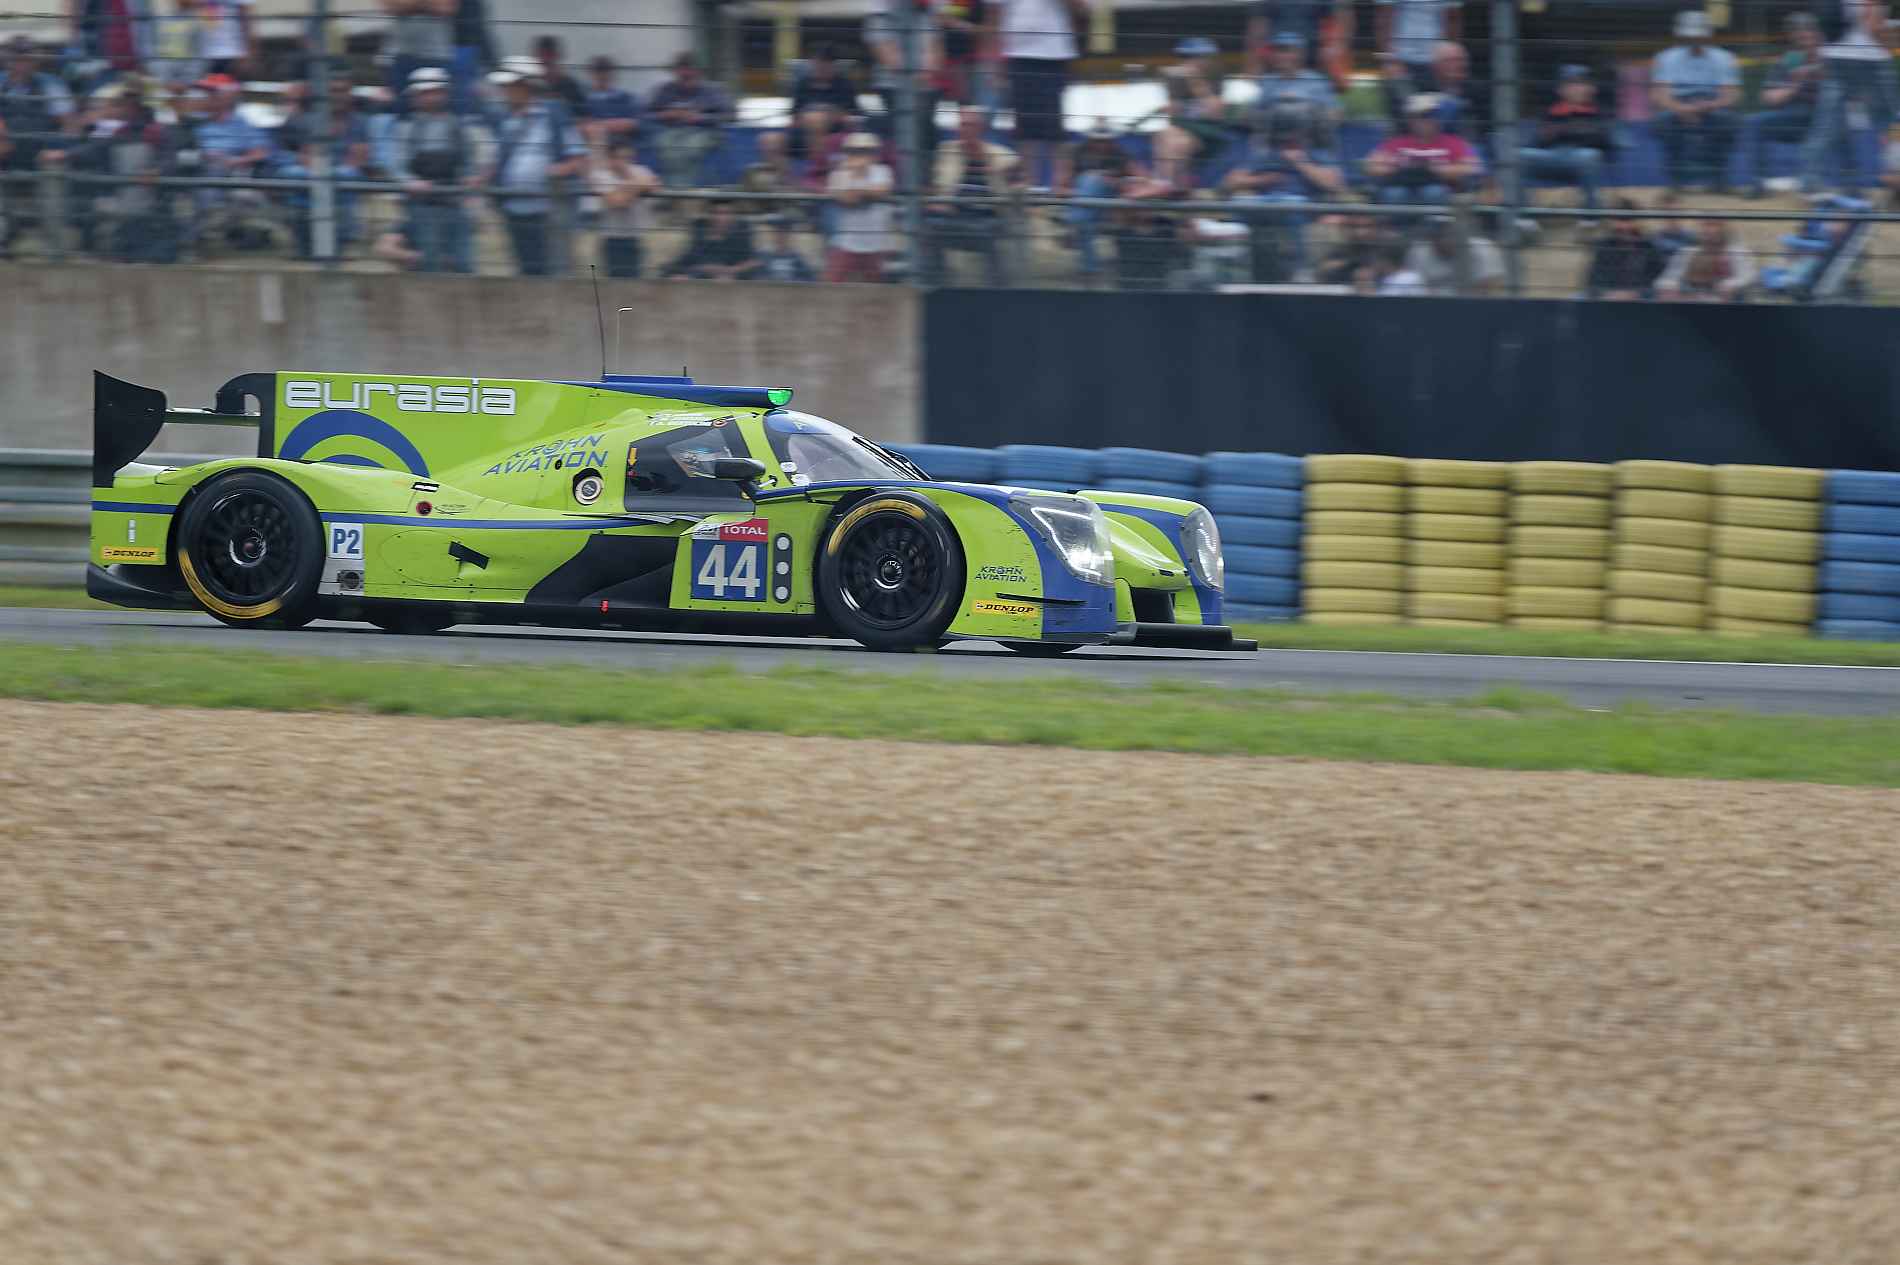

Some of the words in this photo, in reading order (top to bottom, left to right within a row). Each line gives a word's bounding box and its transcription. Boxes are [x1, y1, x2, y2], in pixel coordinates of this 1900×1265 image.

[285, 377, 516, 415] eurasia
[481, 450, 608, 476] AVIATION
[332, 528, 361, 555] P2
[112, 549, 156, 558] DUNLOP
[697, 544, 761, 598] 44
[975, 573, 1028, 583] AVIATION
[980, 565, 1024, 575] KROHN
[983, 603, 1035, 613] DUNLOP
